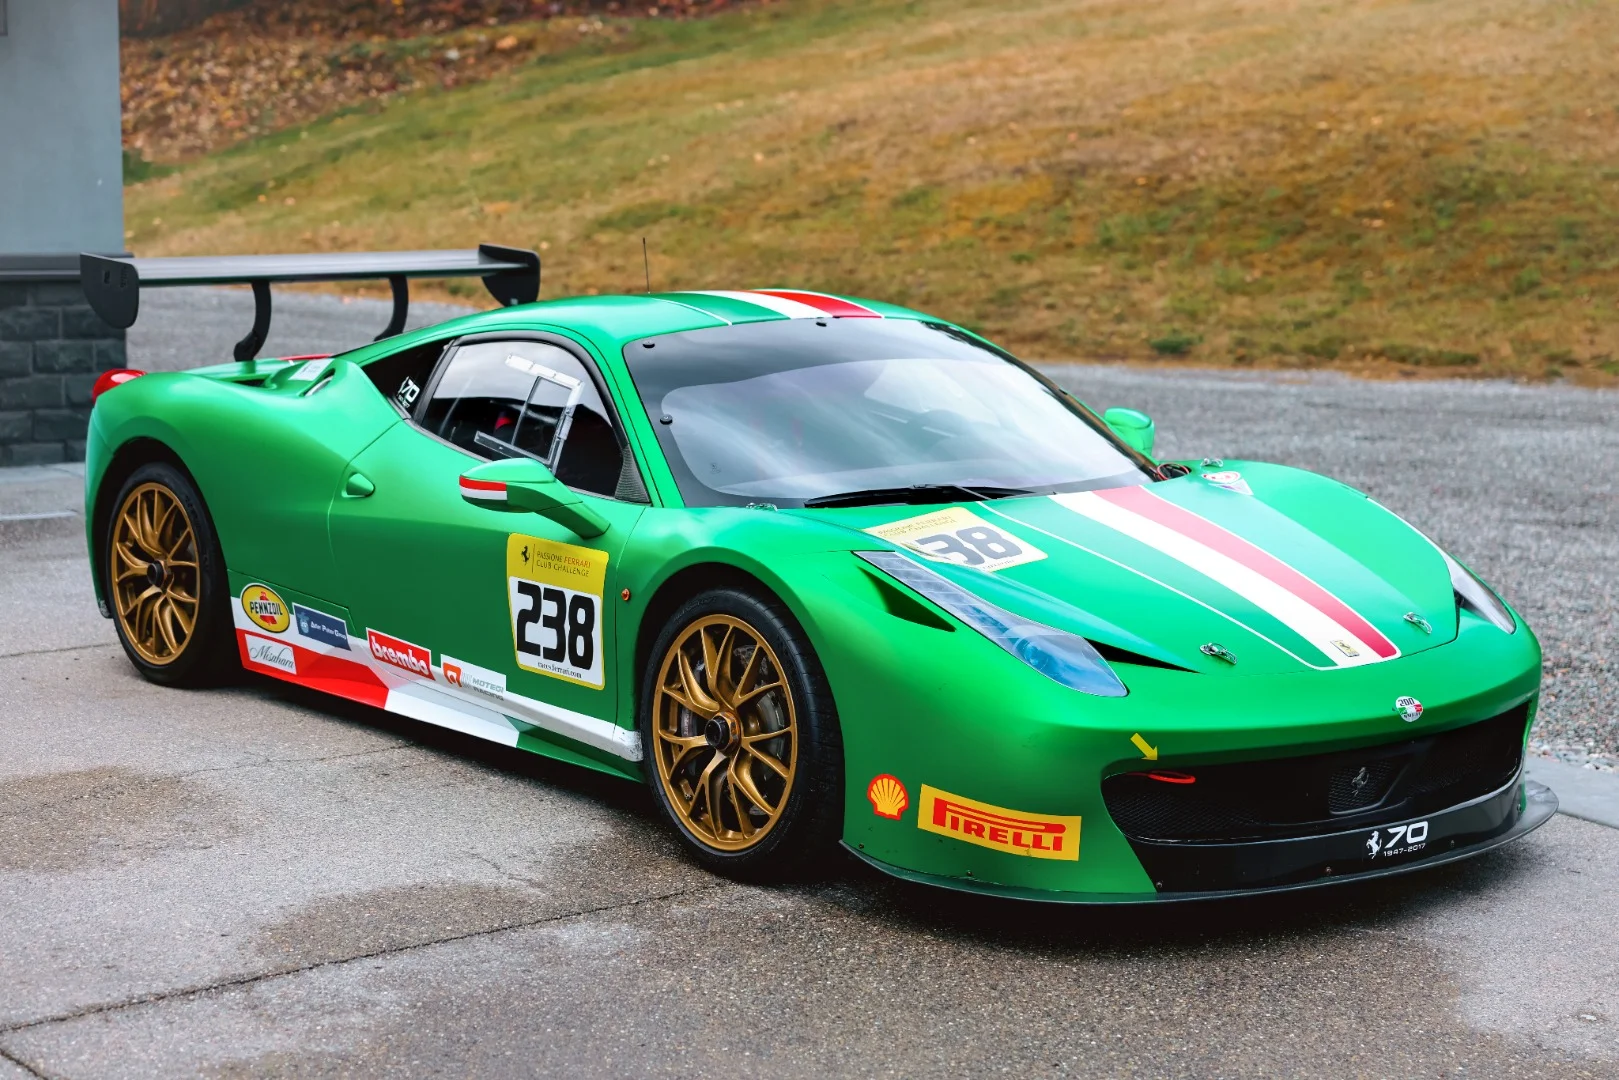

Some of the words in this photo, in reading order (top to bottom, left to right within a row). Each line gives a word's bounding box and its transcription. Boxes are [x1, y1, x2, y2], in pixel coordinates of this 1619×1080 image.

[536, 550, 563, 563] PASSIONE
[563, 556, 591, 569] FERRARI
[536, 560, 552, 570] CLUB
[553, 563, 590, 577] CHALLENGE
[249, 601, 283, 616] PENNZOIL
[516, 580, 595, 671] 238
[371, 635, 430, 676] brembo
[932, 797, 1067, 852] PIRELLI
[1384, 820, 1429, 849] 70
[1383, 842, 1427, 857] 1947-2017
